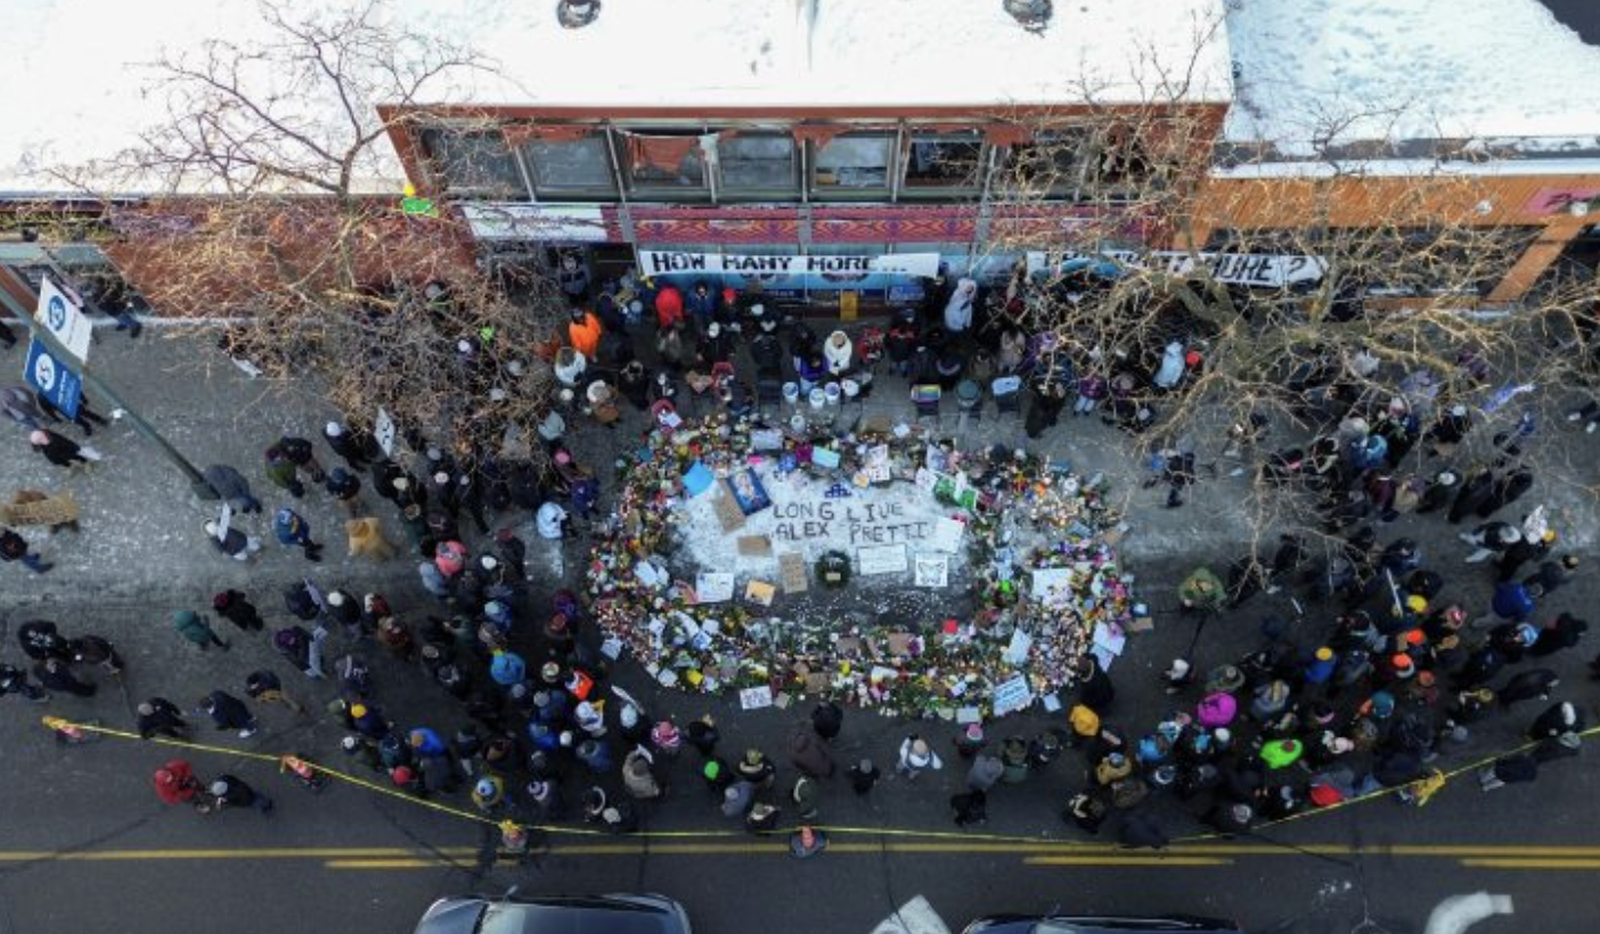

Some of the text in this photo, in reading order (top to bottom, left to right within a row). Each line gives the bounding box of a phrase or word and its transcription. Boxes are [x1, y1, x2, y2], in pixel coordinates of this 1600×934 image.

[651, 252, 706, 272] HOW
[722, 253, 792, 271] MANY
[773, 501, 835, 521] LONG
[775, 521, 830, 541] ALEX
[849, 521, 928, 545] PRETTI
